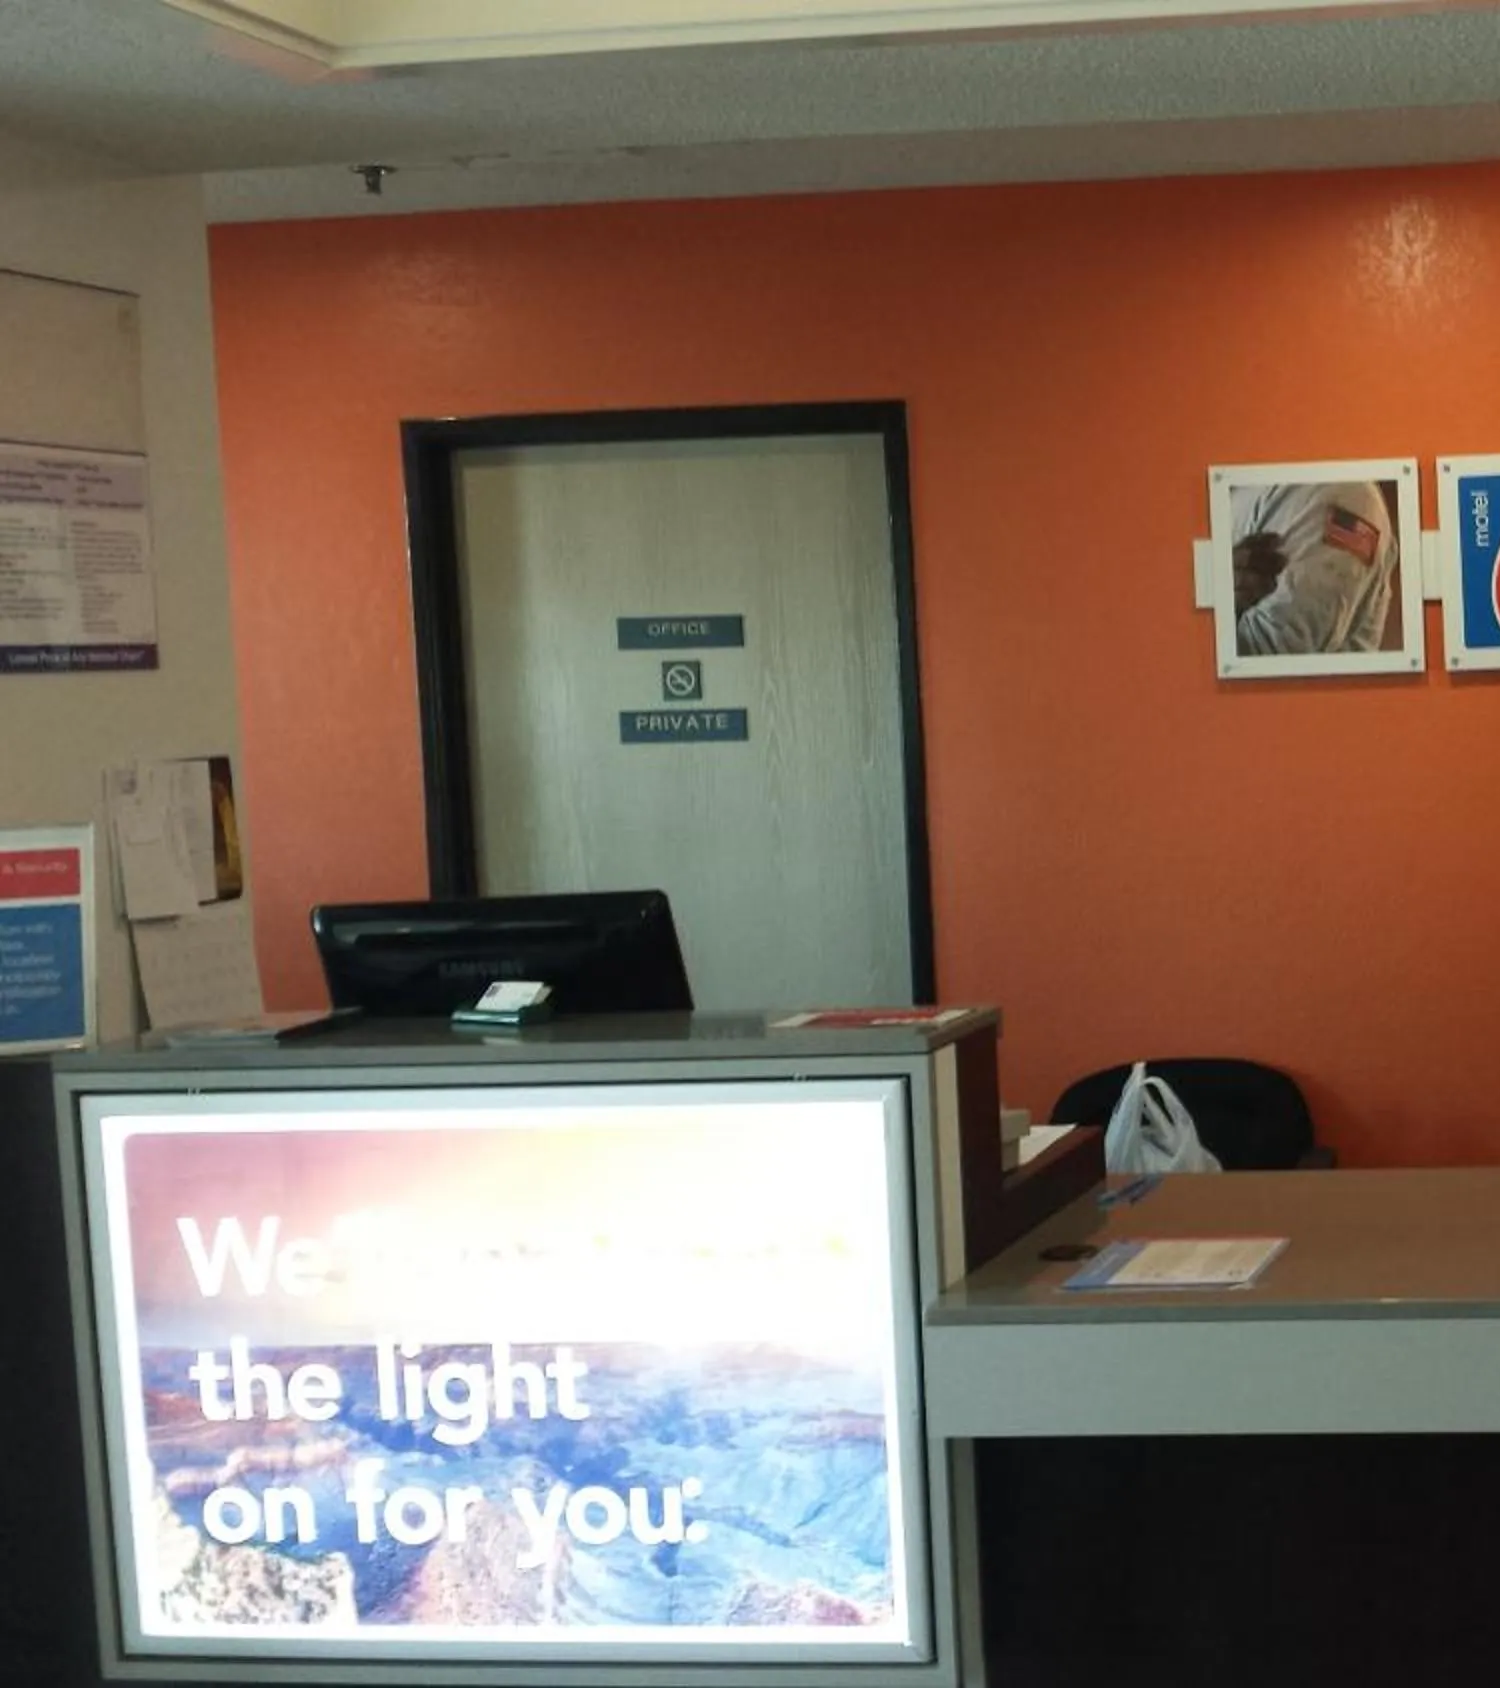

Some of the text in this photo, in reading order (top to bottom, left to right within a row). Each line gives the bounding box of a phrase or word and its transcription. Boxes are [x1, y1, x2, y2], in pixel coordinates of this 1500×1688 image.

[1470, 489, 1489, 547] motel
[647, 621, 711, 637] OFFICE
[635, 712, 729, 731] PRIVATE
[189, 1336, 591, 1446] the light
[203, 1486, 317, 1545] on
[346, 1457, 485, 1546] for
